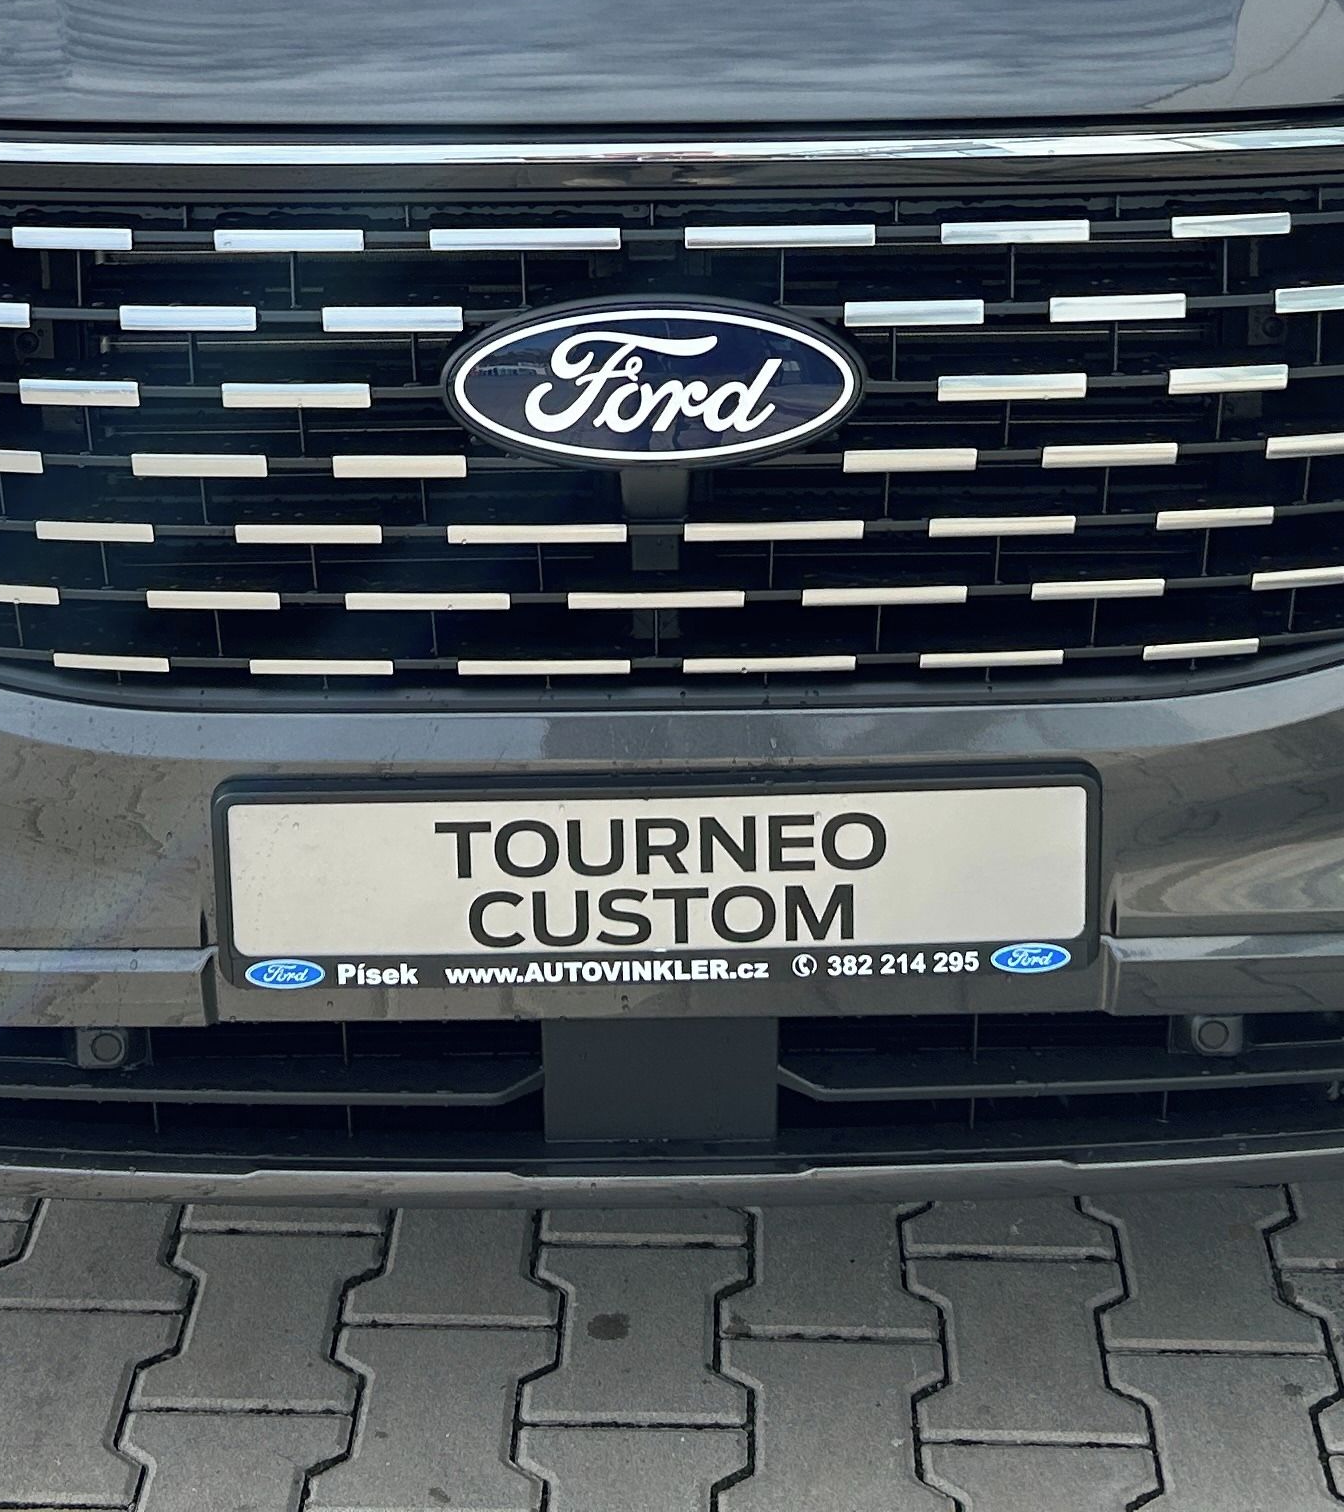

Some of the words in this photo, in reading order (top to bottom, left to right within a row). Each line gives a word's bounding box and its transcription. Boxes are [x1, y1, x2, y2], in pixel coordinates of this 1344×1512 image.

[524, 330, 783, 434] Ford
[433, 811, 888, 879] TOURNEO
[467, 883, 855, 948] CUSTOM
[262, 961, 309, 984] Ford
[336, 961, 420, 986] Písek
[444, 958, 770, 985] www.AUTOVINKLER.cz
[826, 953, 873, 977] 382
[879, 952, 927, 975] 214
[932, 950, 980, 974] 295
[1007, 945, 1053, 968] Ford
